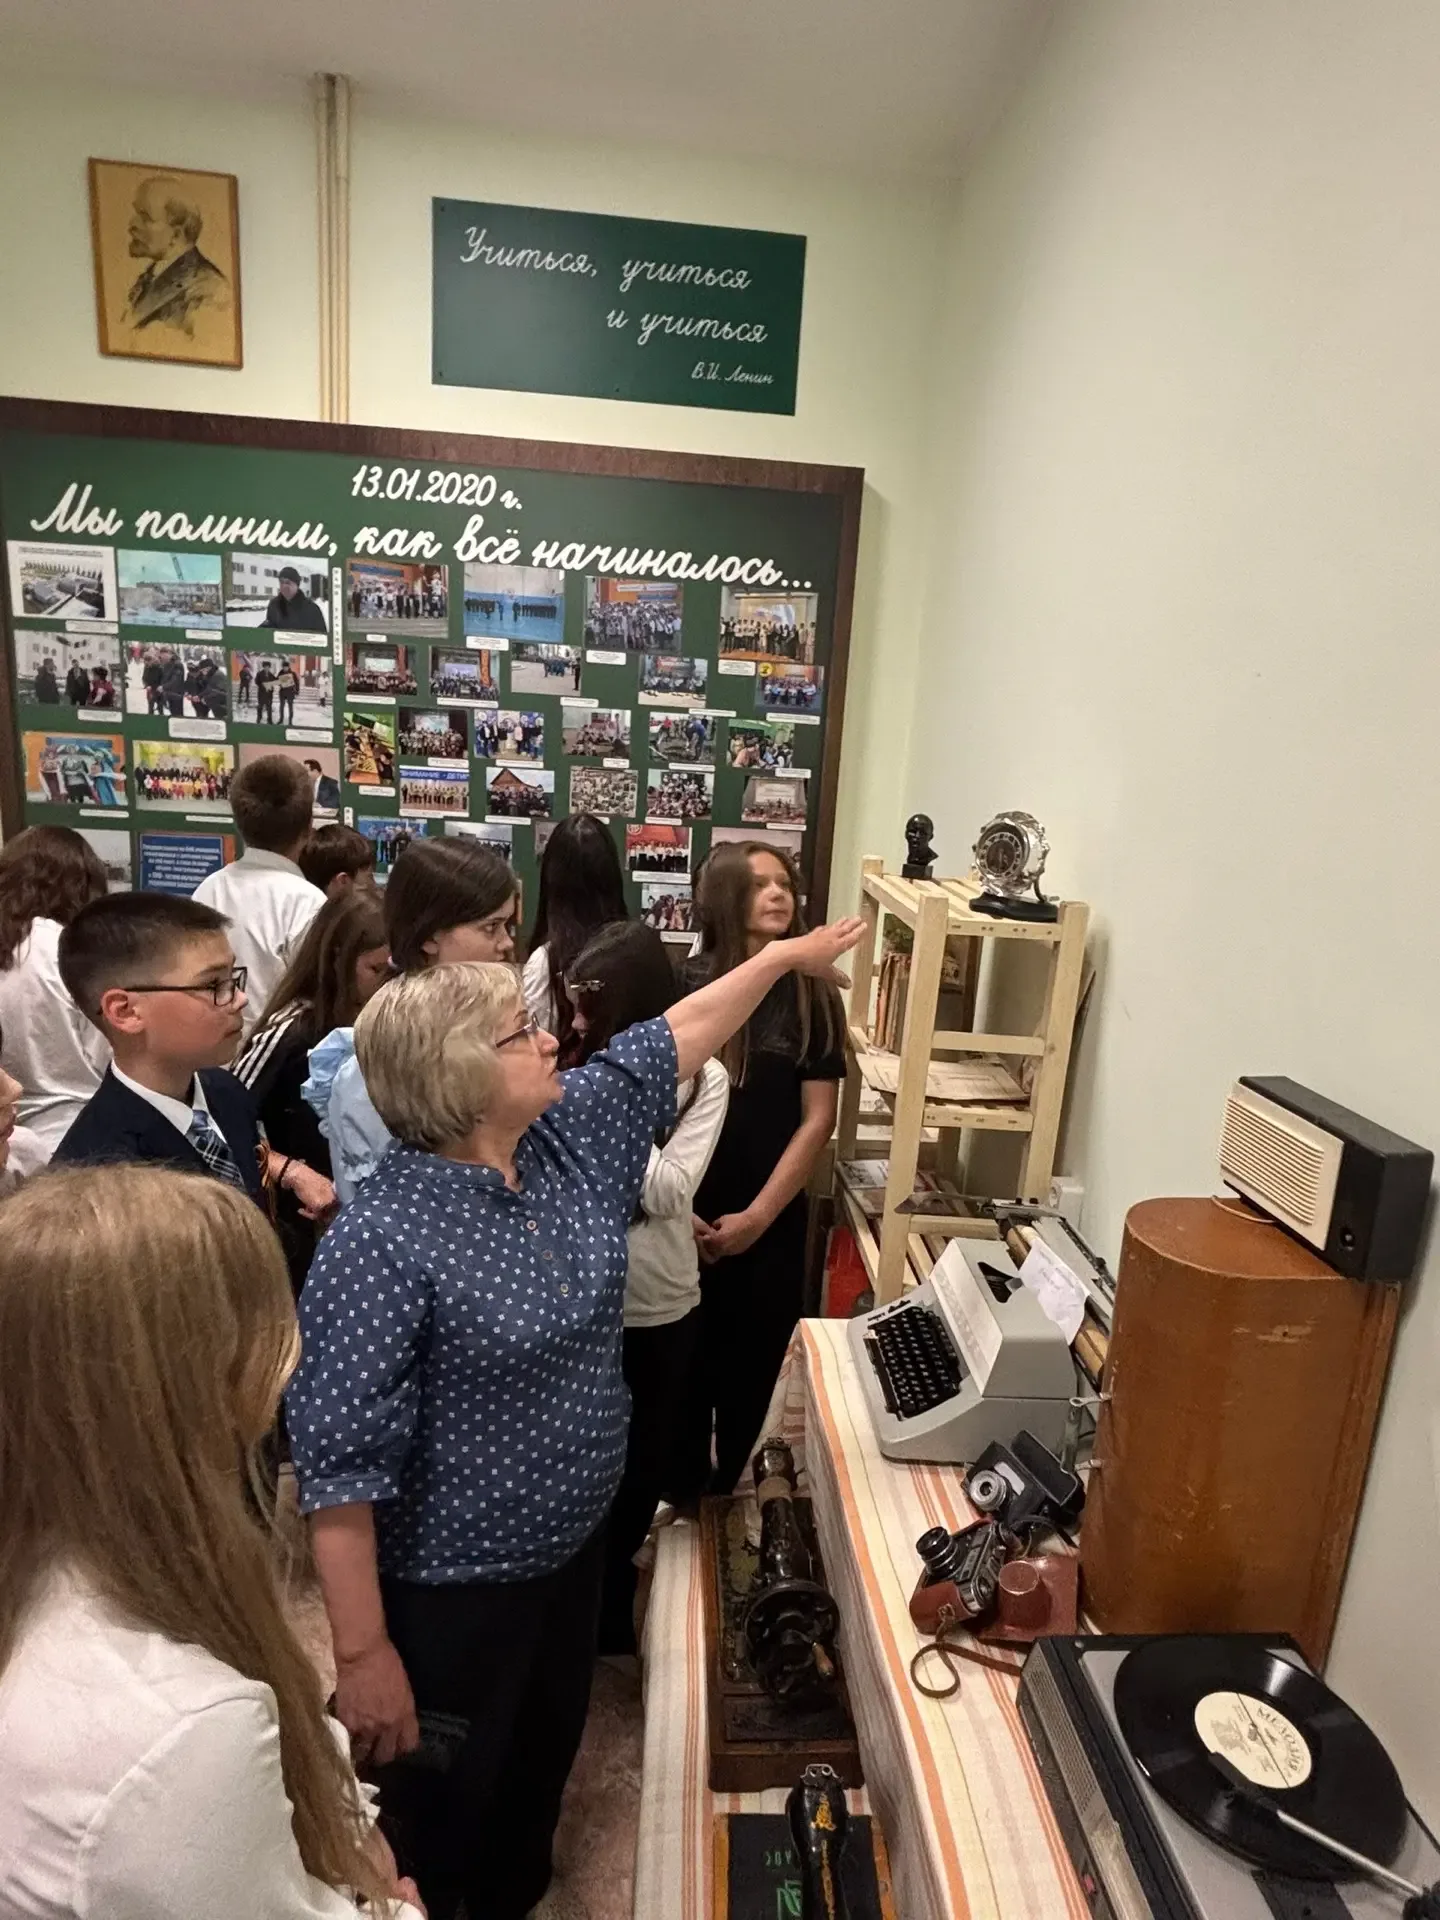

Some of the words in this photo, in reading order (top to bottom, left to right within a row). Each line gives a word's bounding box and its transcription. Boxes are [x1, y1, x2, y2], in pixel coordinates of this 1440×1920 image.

[459, 226, 598, 277] Учиться,
[619, 260, 752, 293] учиться
[606, 308, 629, 329] и
[637, 313, 768, 346] учиться
[691, 361, 721, 381] В.И.
[724, 364, 774, 385] Ленин
[351, 464, 497, 507] 13.01.2020
[499, 488, 523, 510] г.
[30, 482, 124, 536] Мы
[134, 509, 338, 557] помним,
[353, 526, 443, 559] как
[453, 514, 521, 565] всё
[531, 537, 812, 589] начиналось...
